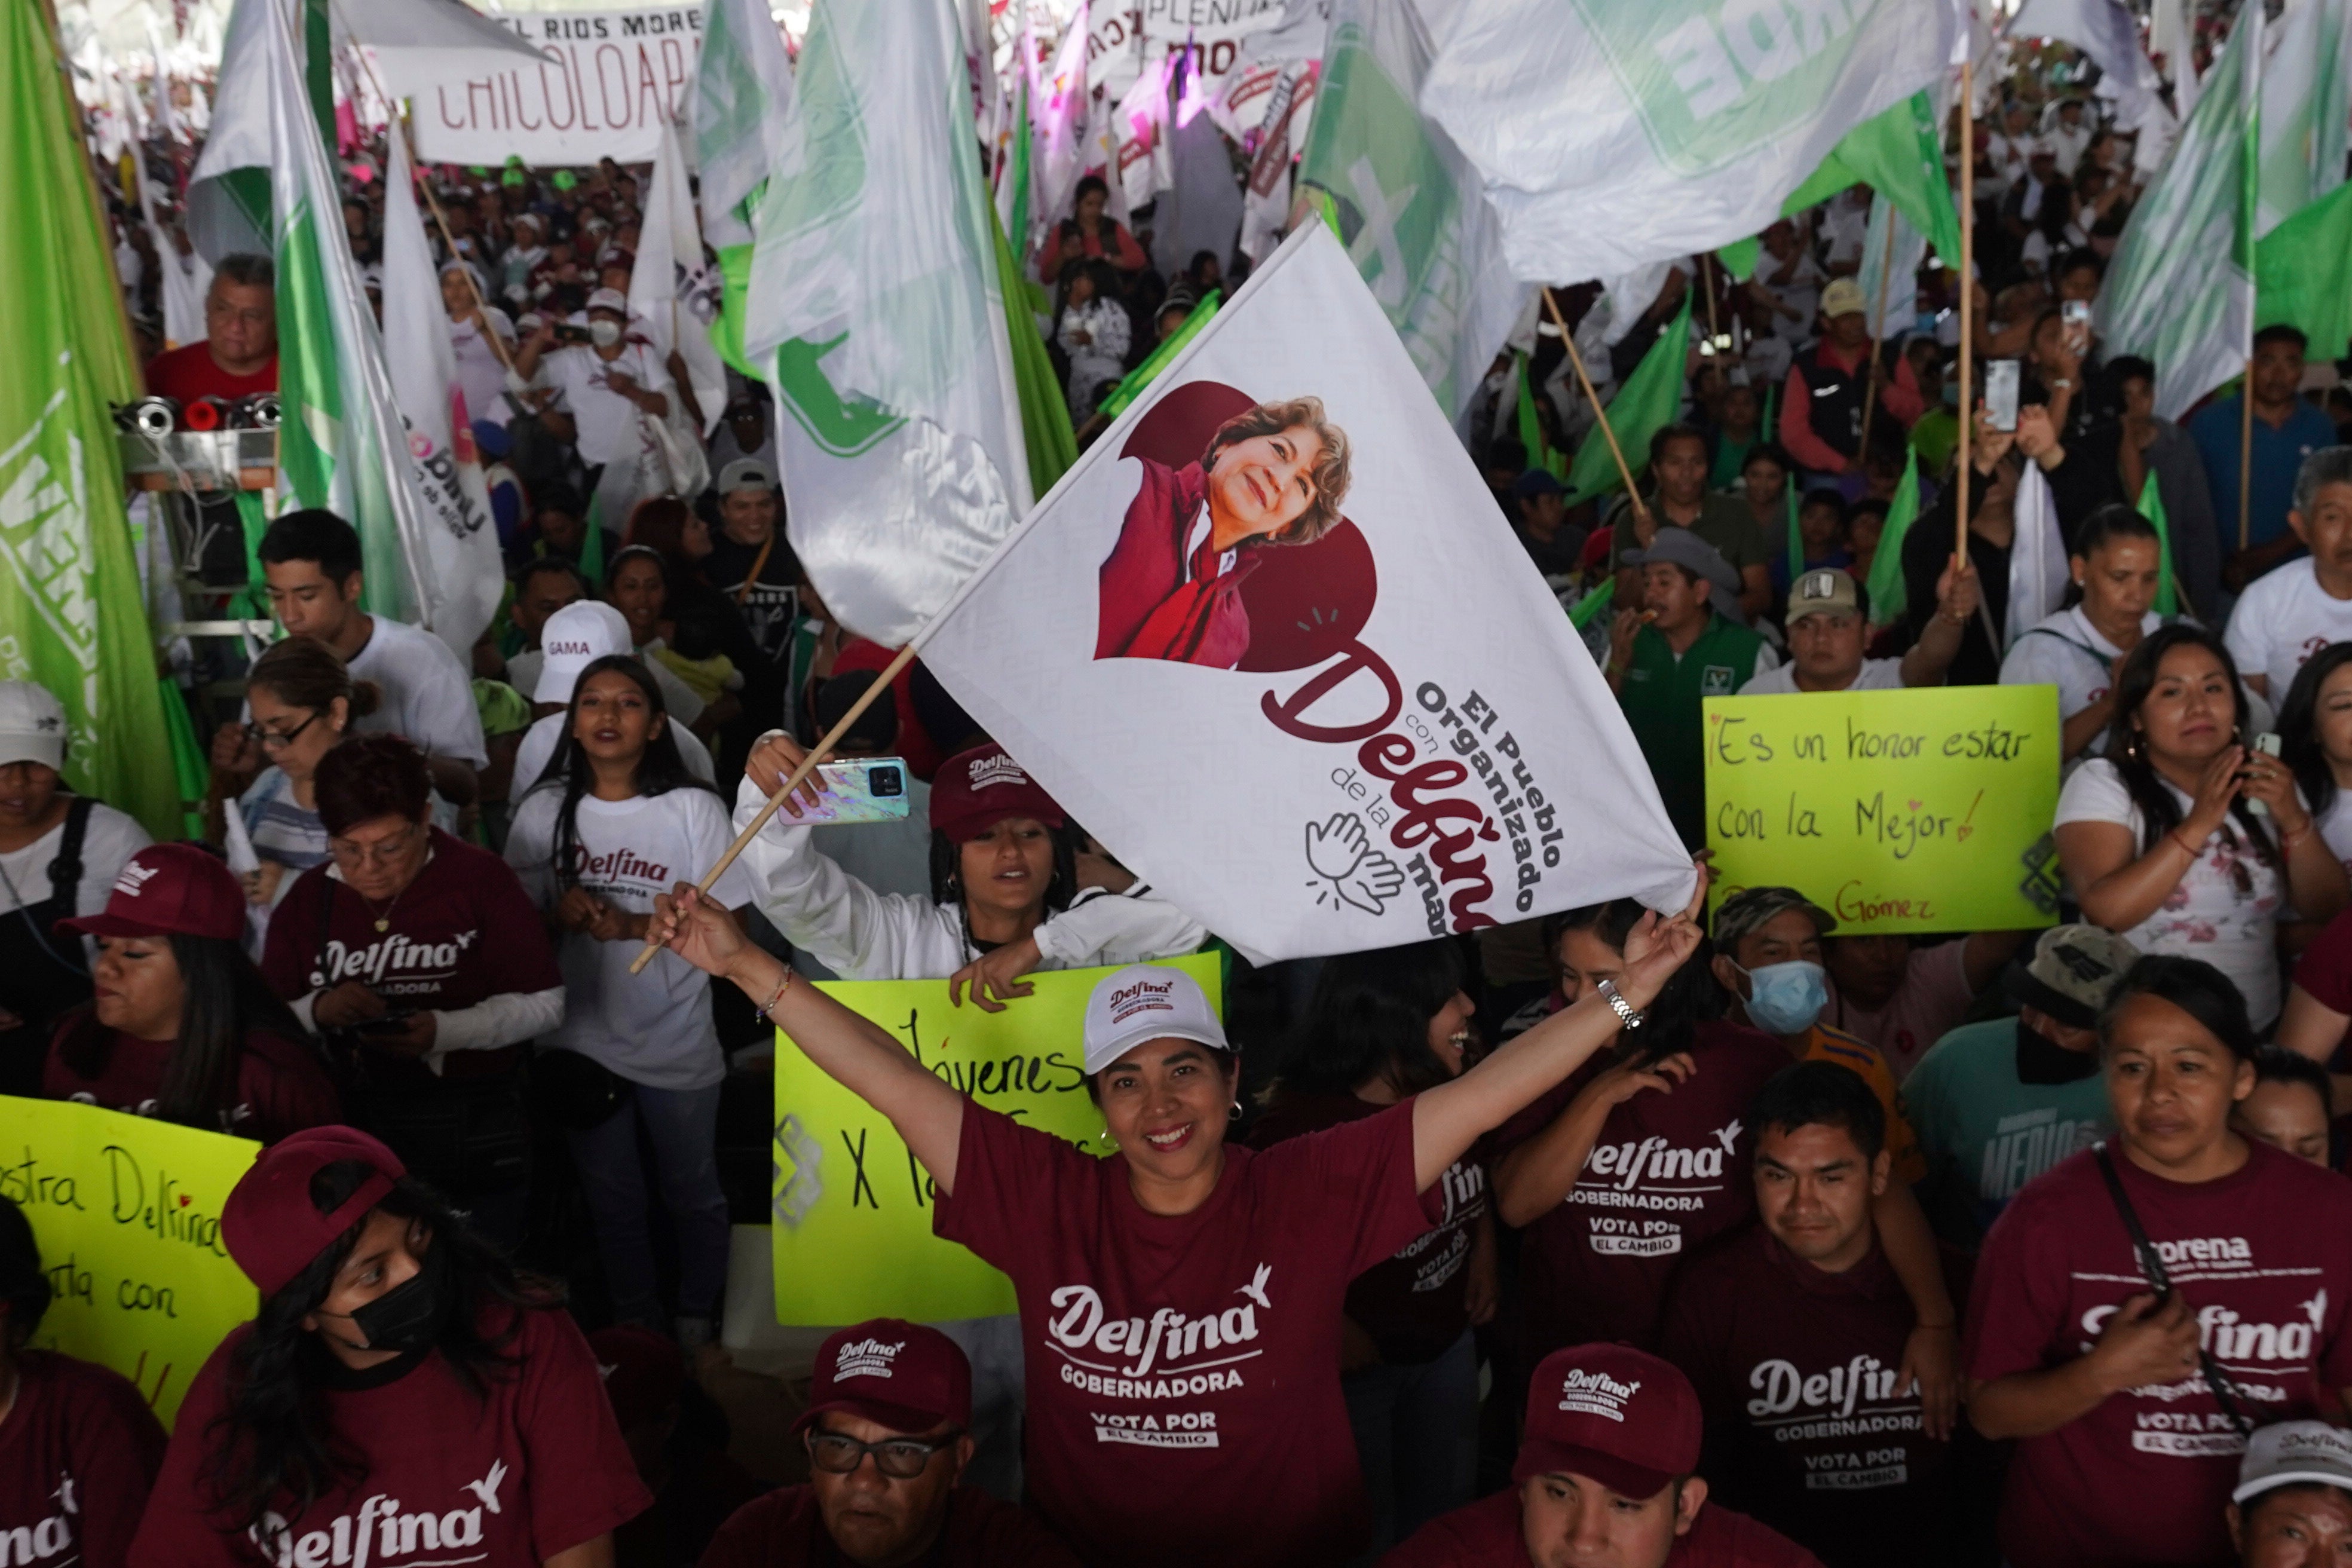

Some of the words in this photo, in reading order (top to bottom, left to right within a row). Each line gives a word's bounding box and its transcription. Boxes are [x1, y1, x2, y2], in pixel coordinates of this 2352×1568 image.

[544, 19, 609, 39] RIOS
[549, 641, 590, 655] GAMA
[1405, 713, 1440, 754] con
[1793, 734, 1827, 762] un
[1846, 715, 1928, 760] honor
[1941, 719, 2032, 762] estar
[1331, 765, 1367, 801] de
[1365, 794, 1391, 829] la
[1416, 681, 1542, 912] Organizado
[1460, 689, 1499, 734] El
[1494, 730, 1564, 868] Pueblo
[1787, 790, 1822, 838] la
[1110, 981, 1169, 1009] Delfina
[0, 1145, 85, 1211] stra
[841, 1128, 879, 1209] X
[1583, 1135, 1723, 1191] elfina
[1589, 1217, 1640, 1236] VOTA
[1596, 1239, 1613, 1250] EL
[1618, 1239, 1674, 1252] CAMBIO
[118, 1278, 177, 1319] con
[837, 1339, 897, 1363] Delfina
[1048, 1284, 1259, 1377] Delfina
[1060, 1363, 1244, 1399] GOBERNADORA
[1563, 1368, 1631, 1394] Delfina
[1747, 1353, 1921, 1419] Delfin
[1089, 1411, 1160, 1431] VOTA
[1165, 1411, 1216, 1431] POR
[1107, 1429, 1123, 1440] EL
[1132, 1431, 1207, 1445] CAMBIO
[1804, 1452, 1861, 1470] VOTA
[1866, 1447, 1906, 1465] POR
